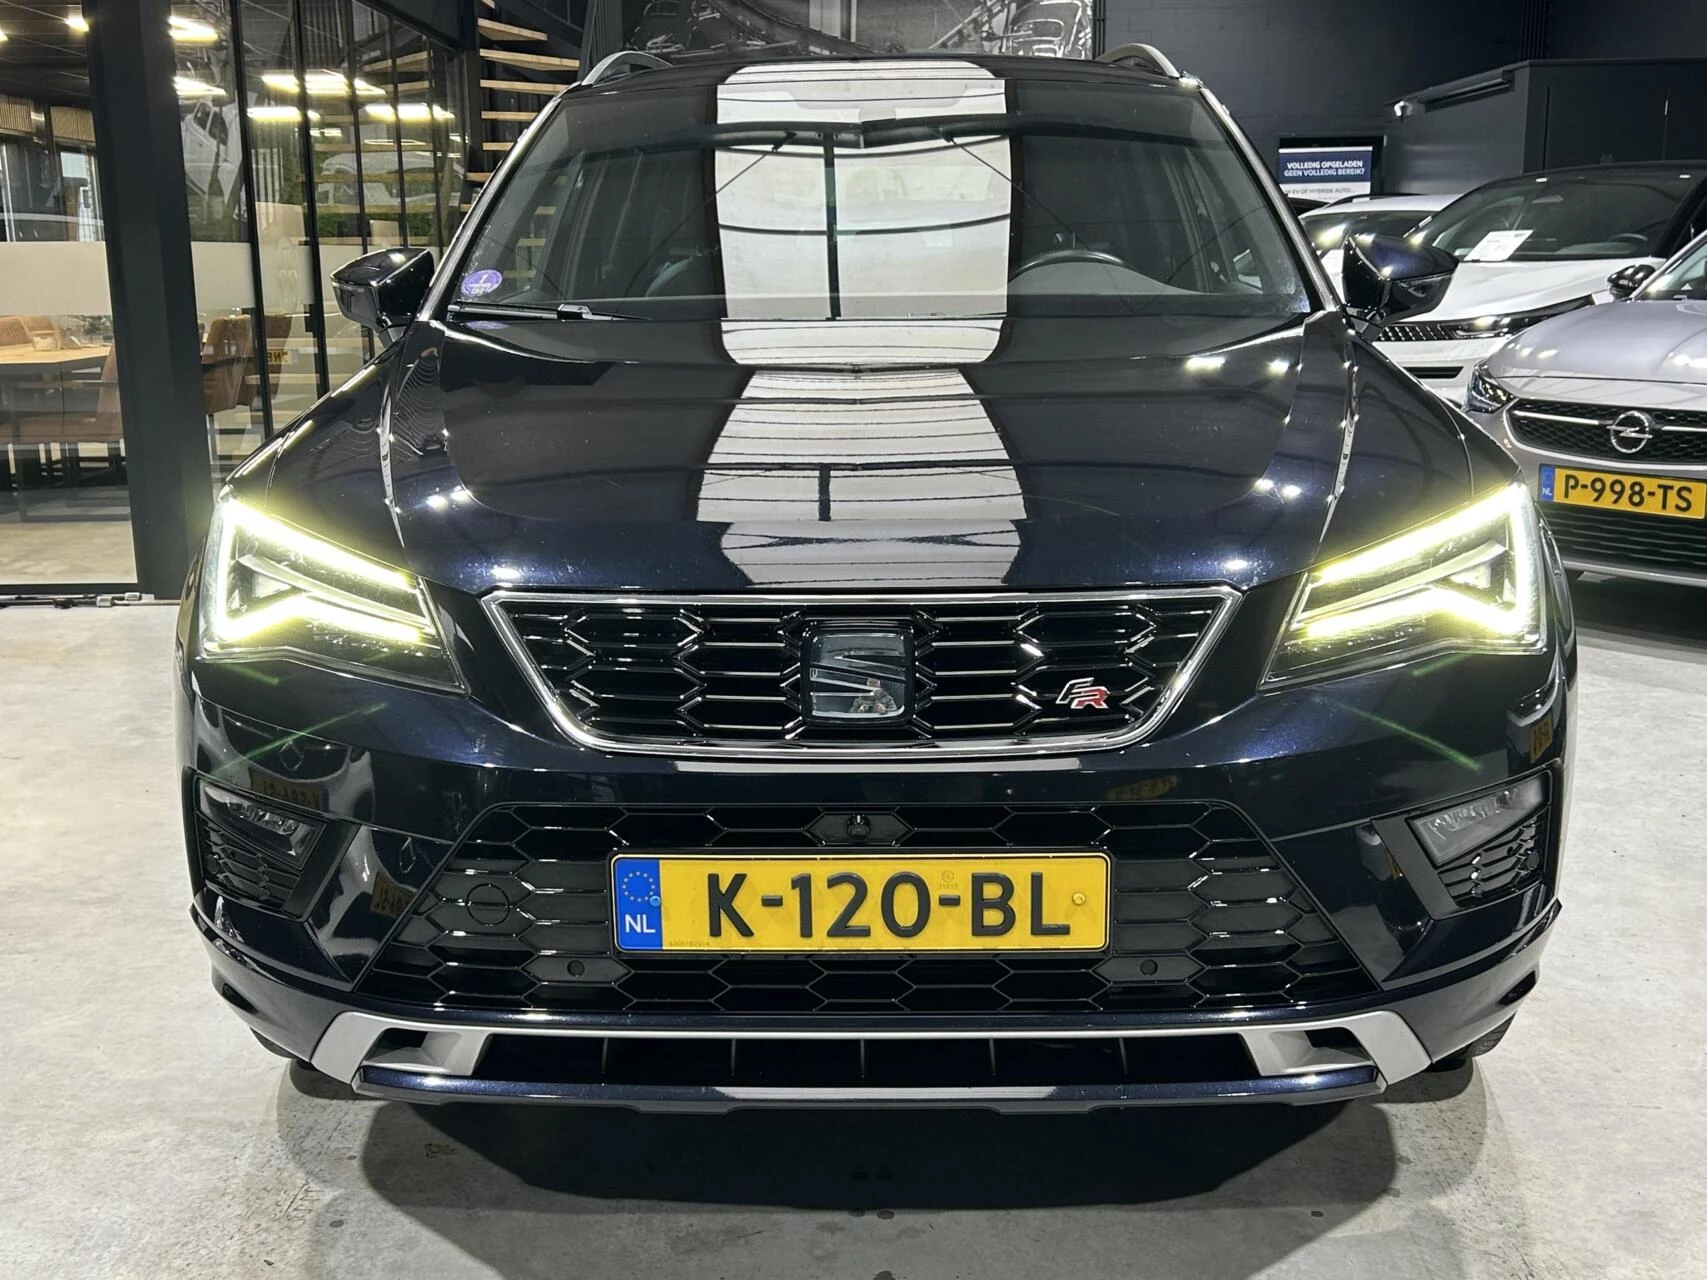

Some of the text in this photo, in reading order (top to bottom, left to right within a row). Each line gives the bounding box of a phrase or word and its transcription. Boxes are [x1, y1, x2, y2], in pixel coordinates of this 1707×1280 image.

[1304, 168, 1336, 176] VOLLEDIG
[1542, 474, 1693, 512] NL P-998-TS
[1055, 676, 1110, 709] FR
[624, 872, 1071, 938] NL K-120-BL
